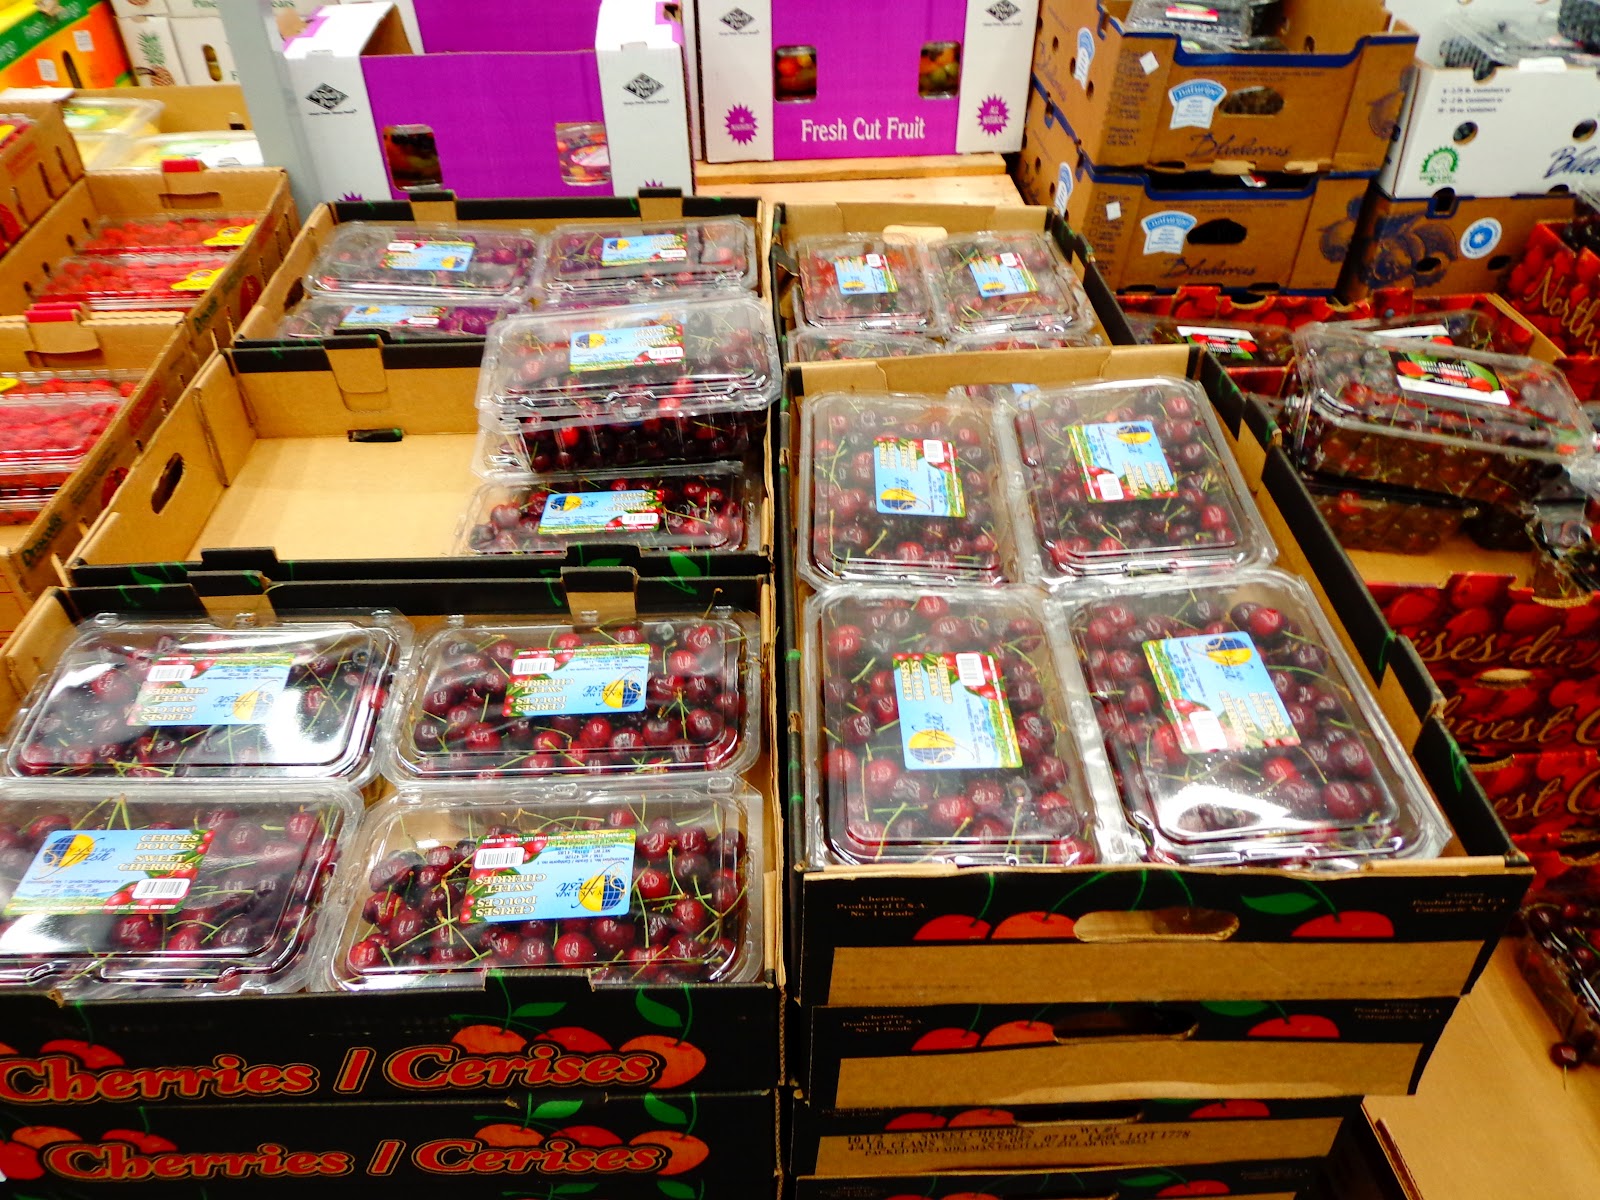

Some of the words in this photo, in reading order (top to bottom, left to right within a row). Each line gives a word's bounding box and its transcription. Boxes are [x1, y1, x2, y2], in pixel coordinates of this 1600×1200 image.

[800, 118, 848, 142] Fresh
[853, 117, 881, 140] Cut
[886, 116, 925, 140] Fruit
[1411, 631, 1504, 663] ises
[1509, 624, 1576, 665] du
[514, 678, 574, 688] CHERRIES
[900, 660, 914, 701] CERISES
[936, 656, 953, 704] CHERRIES
[522, 685, 563, 694] SWEET
[516, 696, 567, 705] DOUCES
[515, 703, 565, 712] CERISES
[140, 833, 200, 842] CERISES
[133, 841, 197, 851] DOUCES
[133, 854, 187, 863] SWEET
[117, 862, 194, 872] CHERRIES
[475, 873, 547, 886] CHERRIES
[484, 882, 534, 894] SWEET
[556, 889, 603, 898] YAKIMA
[477, 895, 538, 908] DOUCES
[475, 906, 536, 918] CERISES
[0, 1054, 318, 1103] Cherries
[385, 1045, 657, 1090] Cerises
[847, 1136, 861, 1144] 10
[921, 1130, 965, 1141] SWEET
[969, 1127, 1034, 1138] CHERRIES
[890, 1139, 936, 1149] CLAMS
[1128, 1131, 1157, 1141] LOT
[1160, 1129, 1192, 1140] 1778
[865, 1147, 909, 1157] PACKED
[911, 1146, 925, 1154] BY
[45, 1142, 352, 1181] Cherries
[413, 1138, 664, 1175] Cerises
